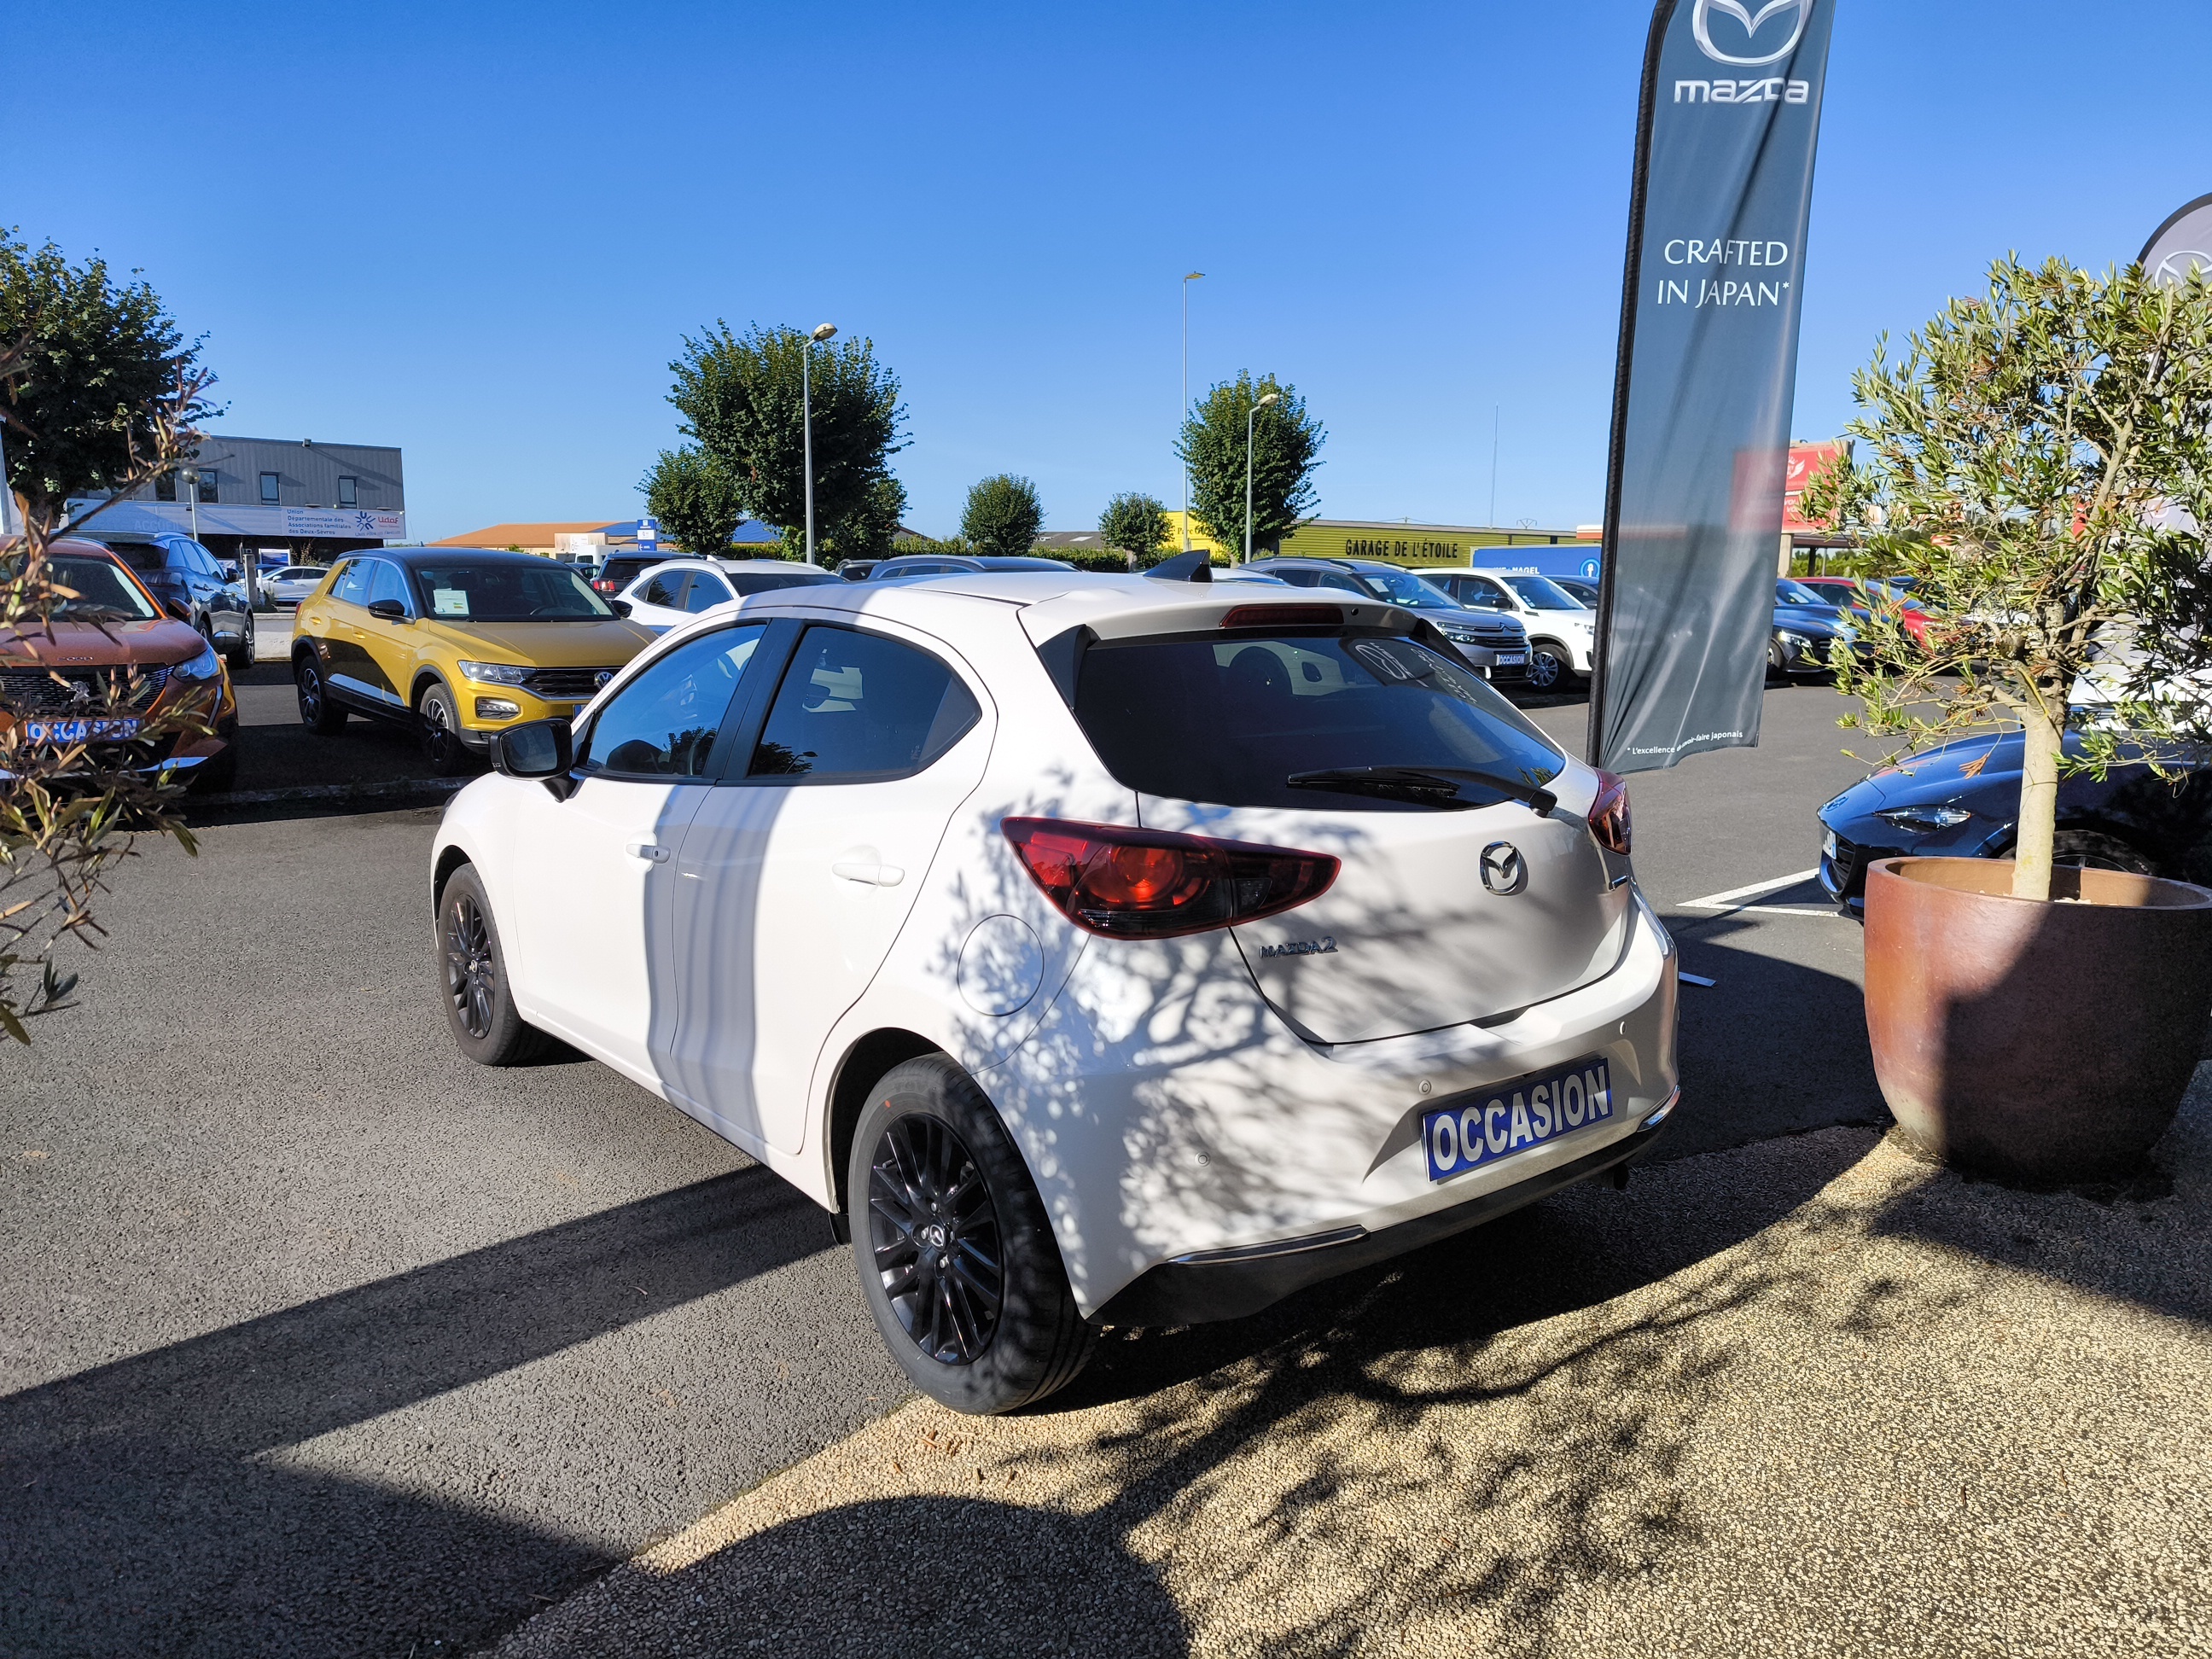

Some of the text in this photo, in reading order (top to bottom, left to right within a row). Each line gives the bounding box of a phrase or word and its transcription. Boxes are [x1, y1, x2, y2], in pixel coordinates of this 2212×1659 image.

[1674, 77, 1809, 104] mazda
[1664, 238, 1789, 266] CRAFTED
[1657, 279, 1689, 305] IN
[1345, 538, 1458, 558] GARAGE DE L'ÉTOILE
[1499, 654, 1525, 665] OCCASION
[1633, 746, 1675, 754] L'excellence
[1710, 730, 1743, 742] japonais
[1432, 1065, 1609, 1171] OCCASION
